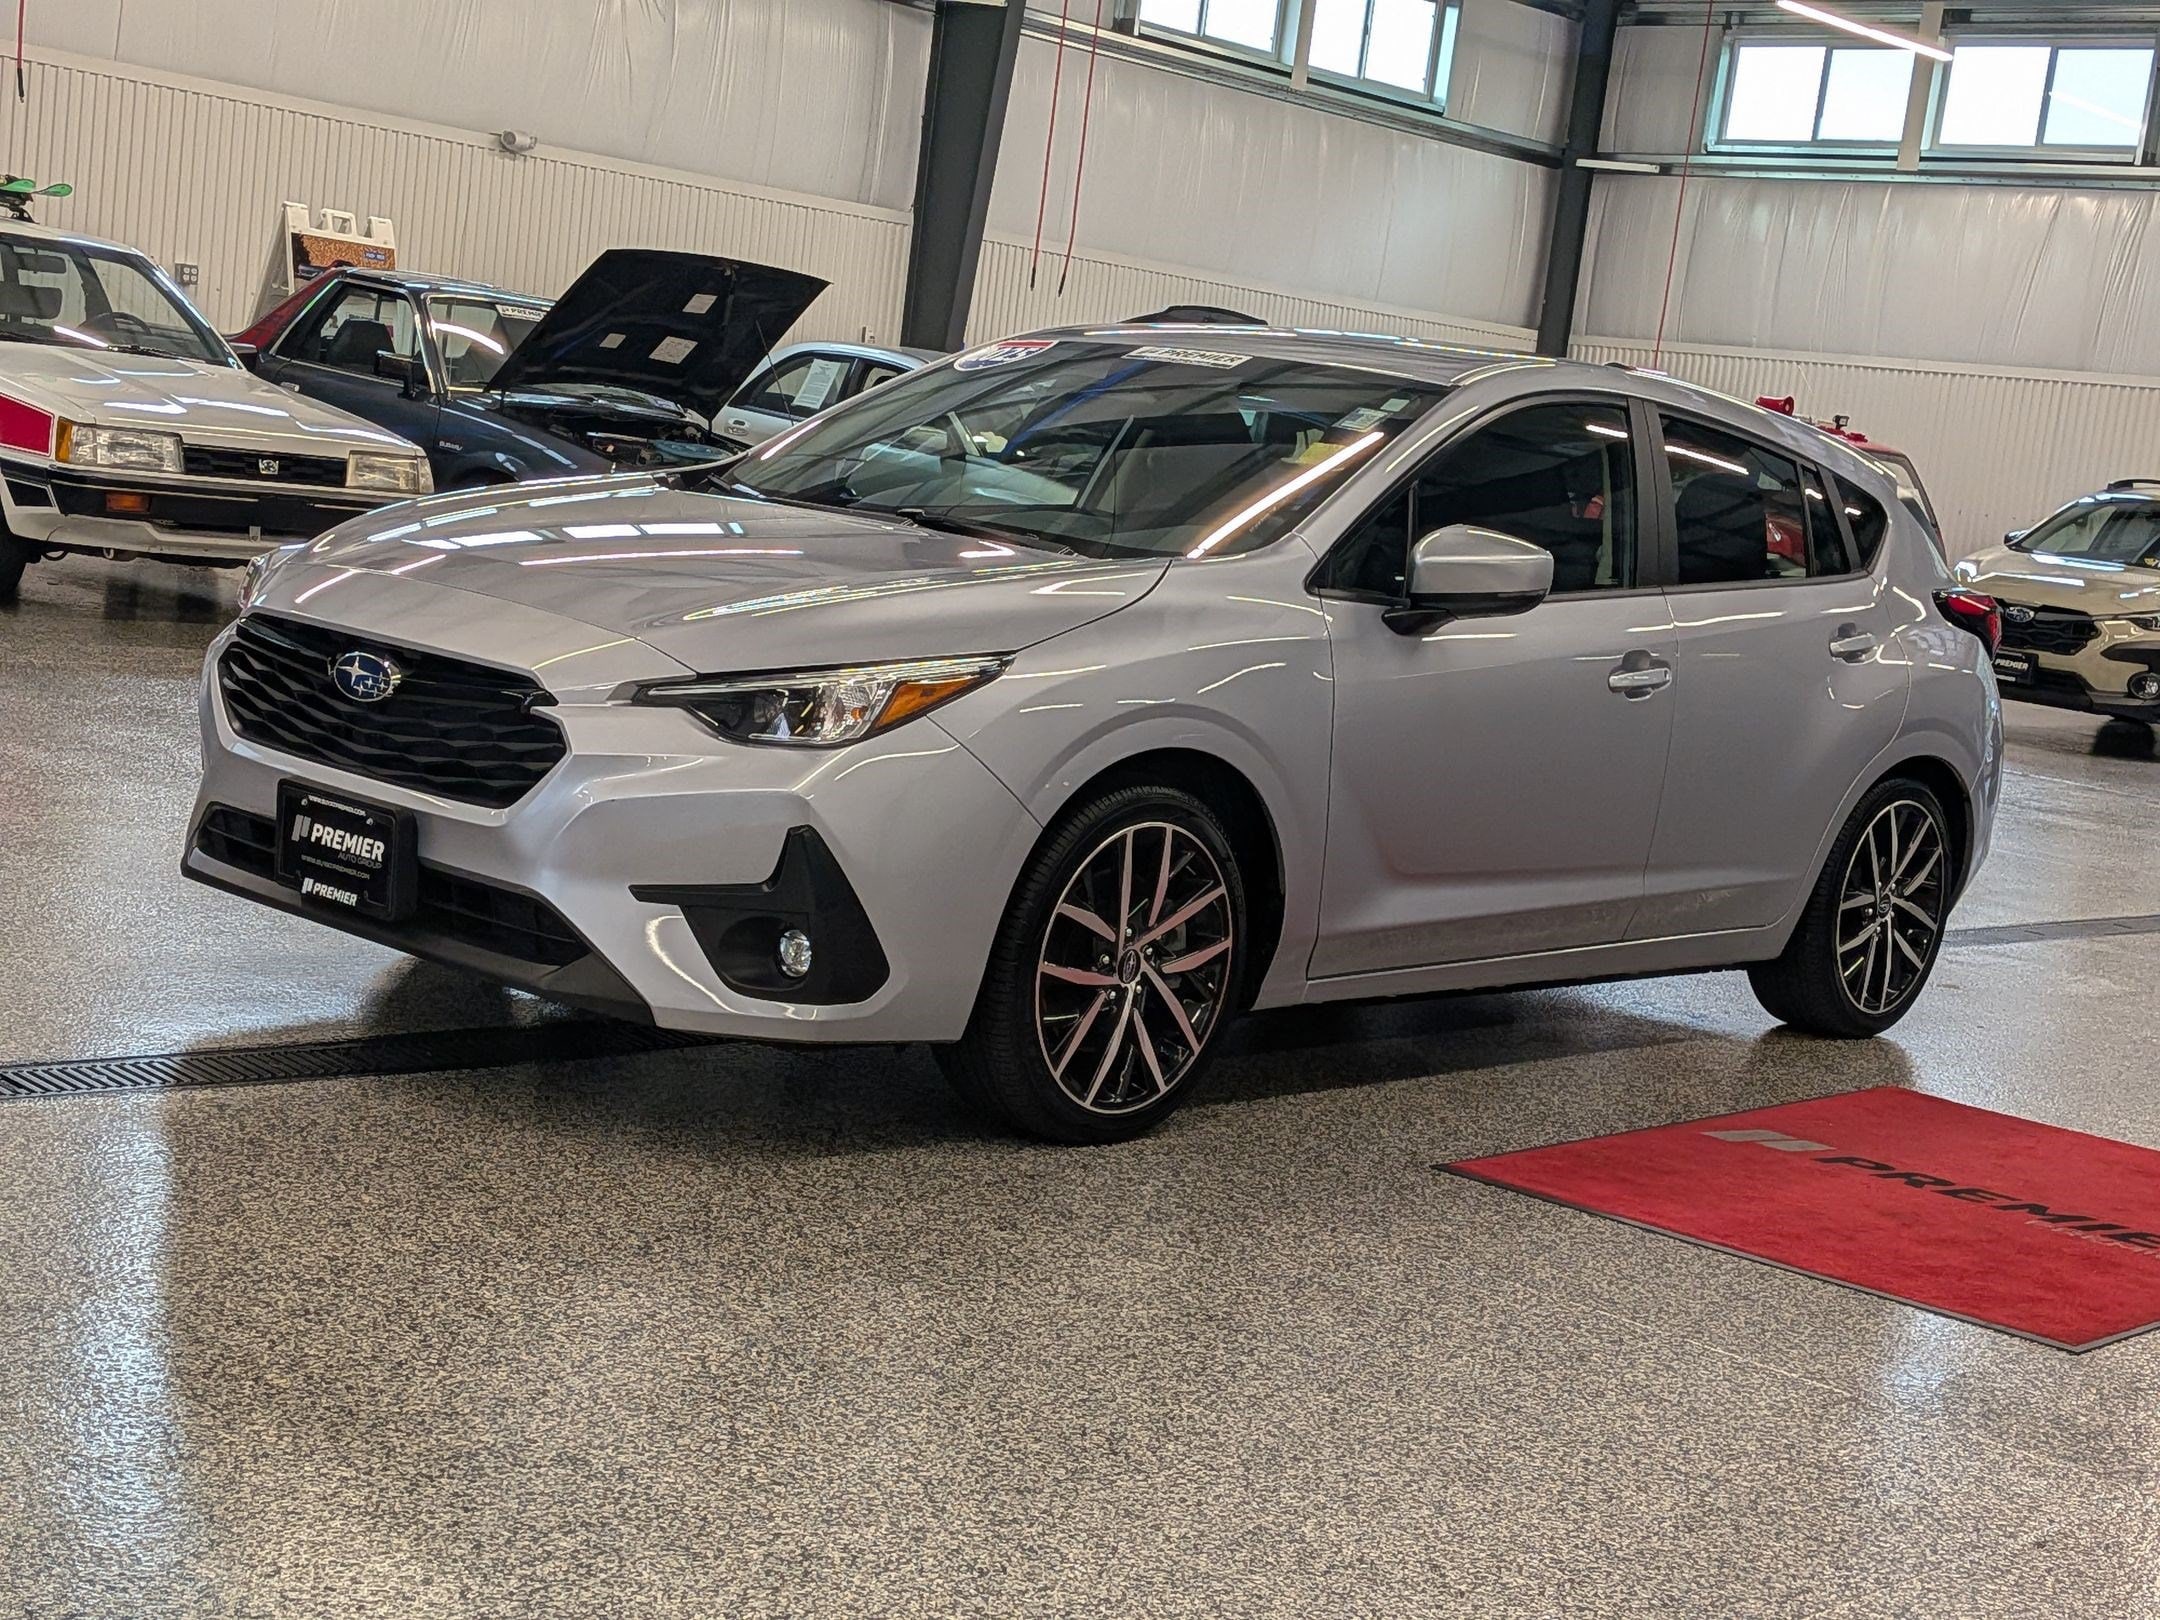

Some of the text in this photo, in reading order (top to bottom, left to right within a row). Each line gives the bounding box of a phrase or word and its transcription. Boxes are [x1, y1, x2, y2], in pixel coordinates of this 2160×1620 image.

[1157, 349, 1243, 363] PREMIER
[310, 823, 385, 862] PREMIER
[338, 852, 356, 864] AUTO
[357, 858, 382, 870] GROUP
[312, 882, 358, 907] PREMIER
